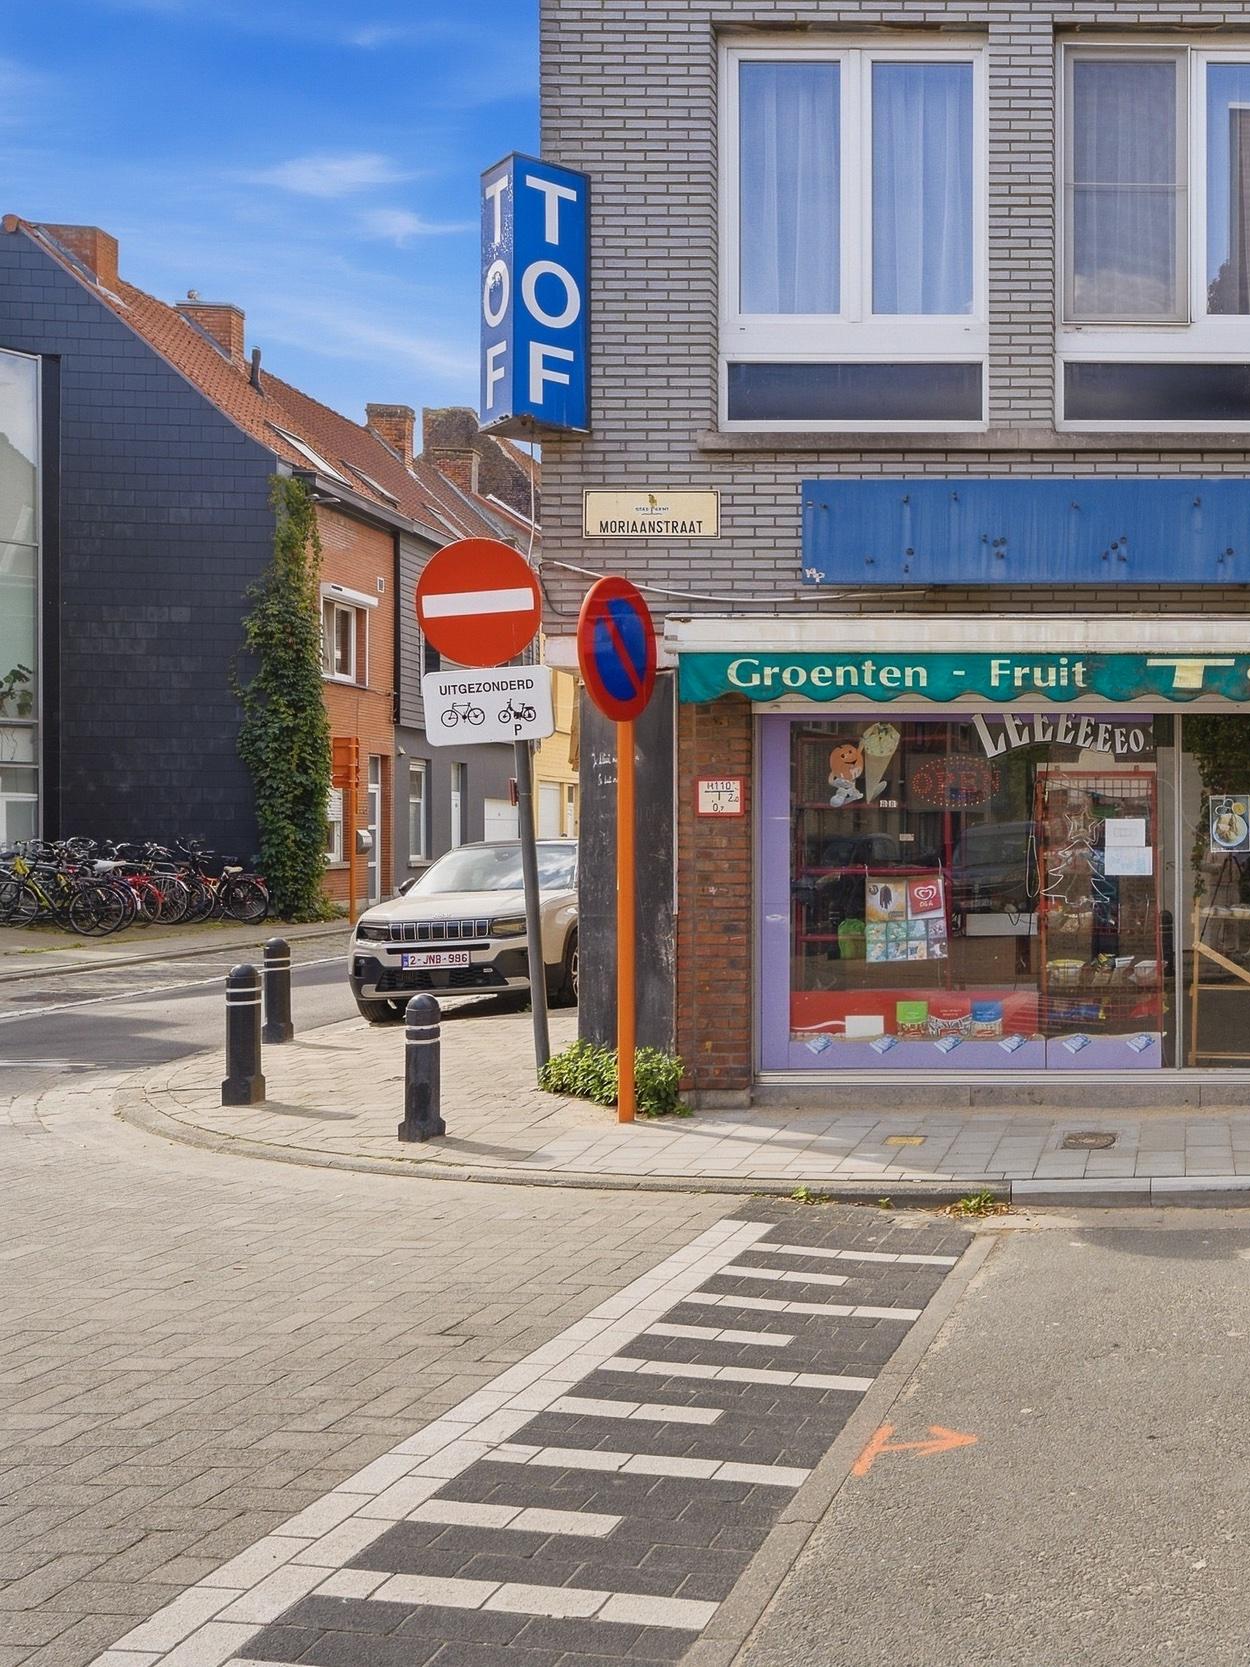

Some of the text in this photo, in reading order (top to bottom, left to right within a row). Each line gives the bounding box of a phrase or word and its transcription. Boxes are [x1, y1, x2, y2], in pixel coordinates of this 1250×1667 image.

[483, 174, 510, 411] TOF
[521, 174, 581, 405] TOF
[599, 520, 703, 534] MORIAANSTRAAT
[727, 658, 928, 687] Groenten
[990, 657, 1088, 687] Fruit
[439, 678, 534, 696] UITGEZONDERD
[514, 723, 522, 736] P
